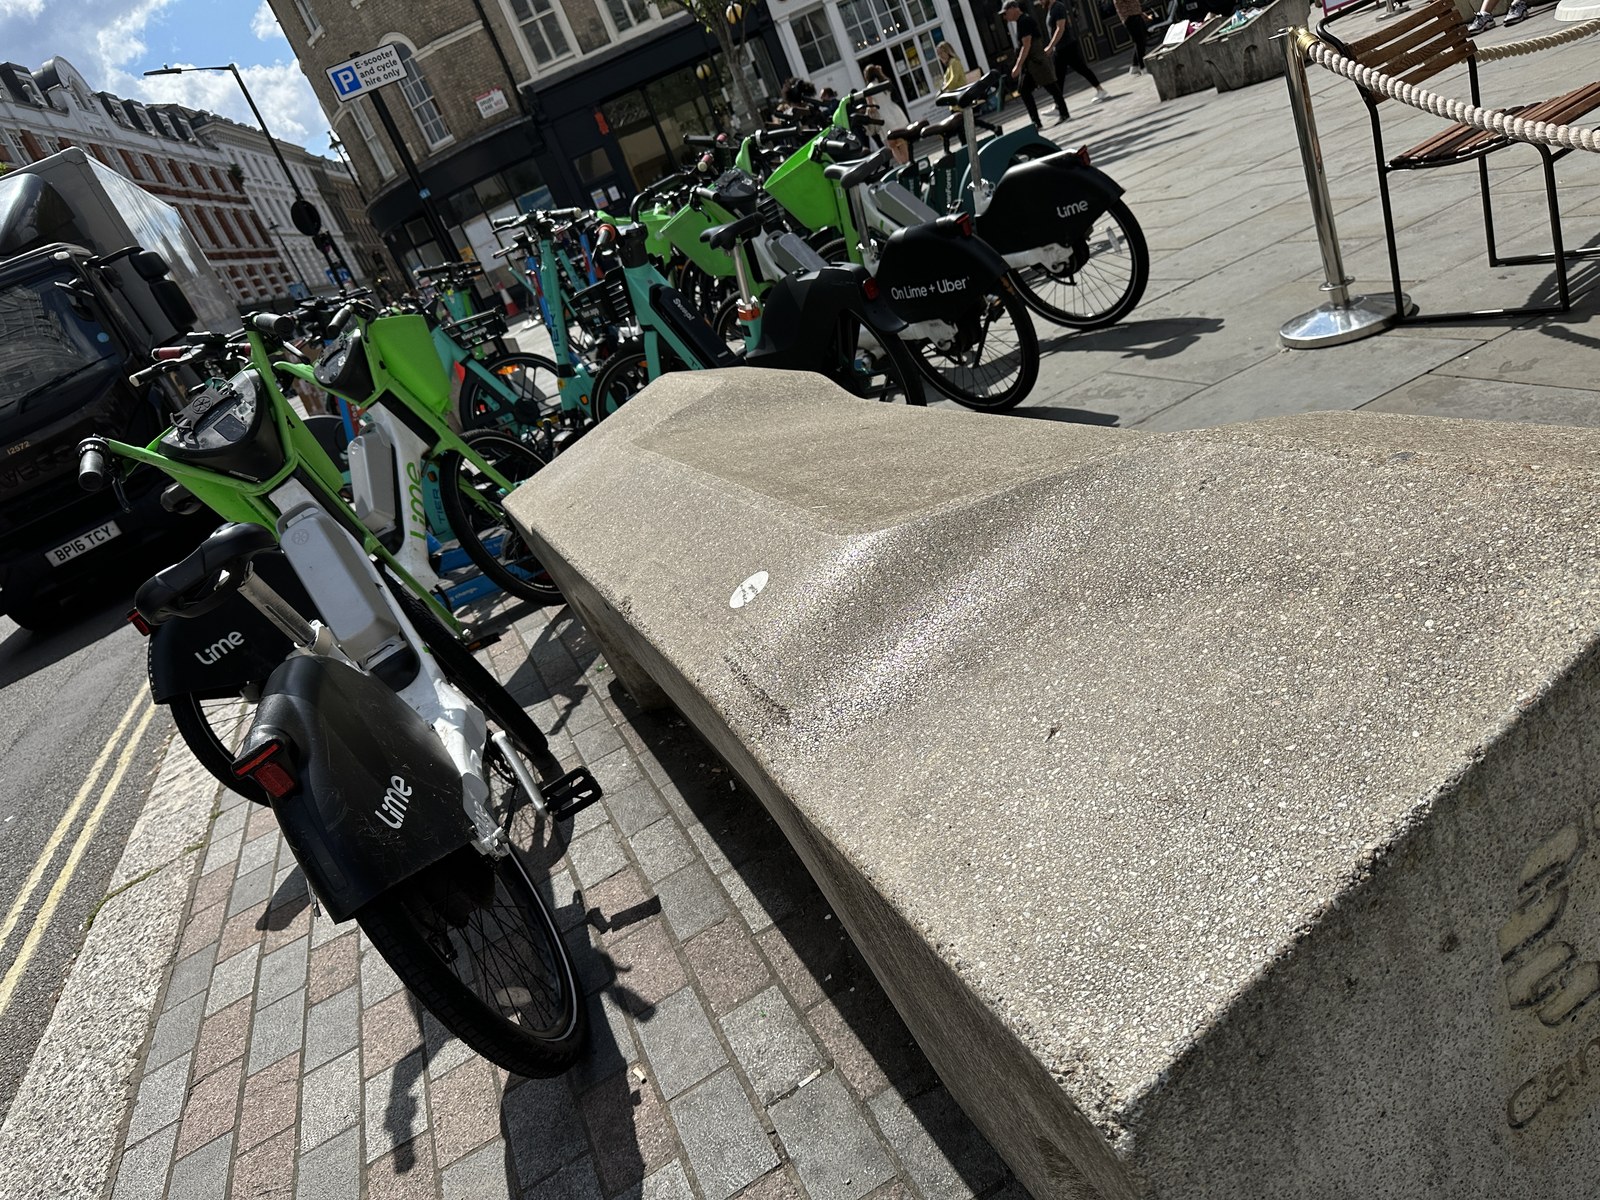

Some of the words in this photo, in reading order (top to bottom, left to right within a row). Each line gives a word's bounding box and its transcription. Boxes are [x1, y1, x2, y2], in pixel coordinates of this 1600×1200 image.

[354, 50, 393, 69] E-scooter
[359, 67, 376, 79] and
[376, 60, 398, 72] cycle
[337, 70, 354, 92] P
[365, 77, 382, 87] hire
[383, 69, 401, 80] only
[1056, 200, 1088, 218] Lime
[904, 285, 928, 299] Lime
[936, 278, 967, 293] Uber
[6, 440, 31, 456] 12572
[432, 488, 447, 525] TIER
[54, 540, 86, 562] BP16
[84, 526, 112, 547] TCY
[194, 631, 246, 665] Lime
[374, 775, 413, 830] Lime
